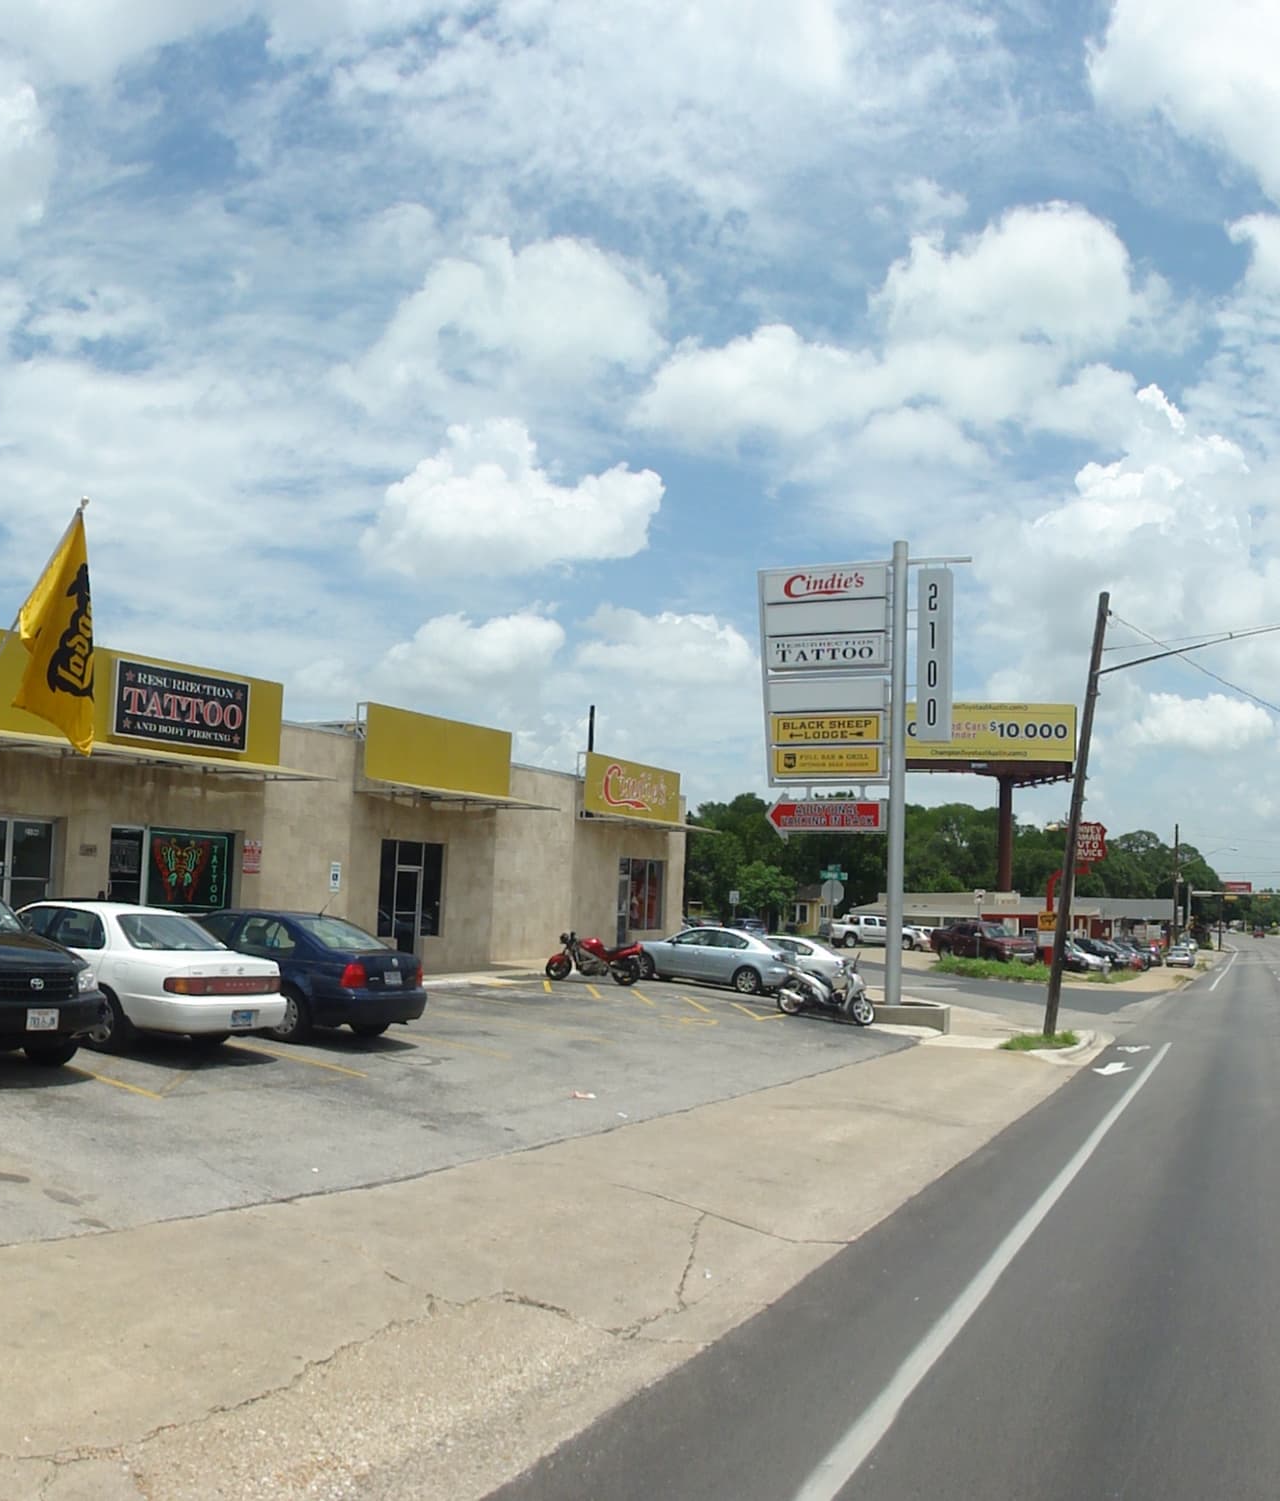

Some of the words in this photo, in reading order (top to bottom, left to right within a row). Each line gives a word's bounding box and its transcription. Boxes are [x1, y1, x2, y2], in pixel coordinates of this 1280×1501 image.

[784, 573, 865, 598] Cindie's
[776, 646, 874, 663] TATTOO
[926, 583, 939, 728] 2100
[137, 672, 234, 699] RESURRECTION
[123, 686, 243, 730] TATTOO
[134, 721, 157, 731] AND
[158, 724, 186, 736] BODY
[187, 727, 231, 741] PIERCING
[782, 721, 825, 730] BLACK
[829, 720, 872, 729] SHEEP
[804, 730, 848, 739] LODGE
[209, 845, 220, 903] TATTOO
